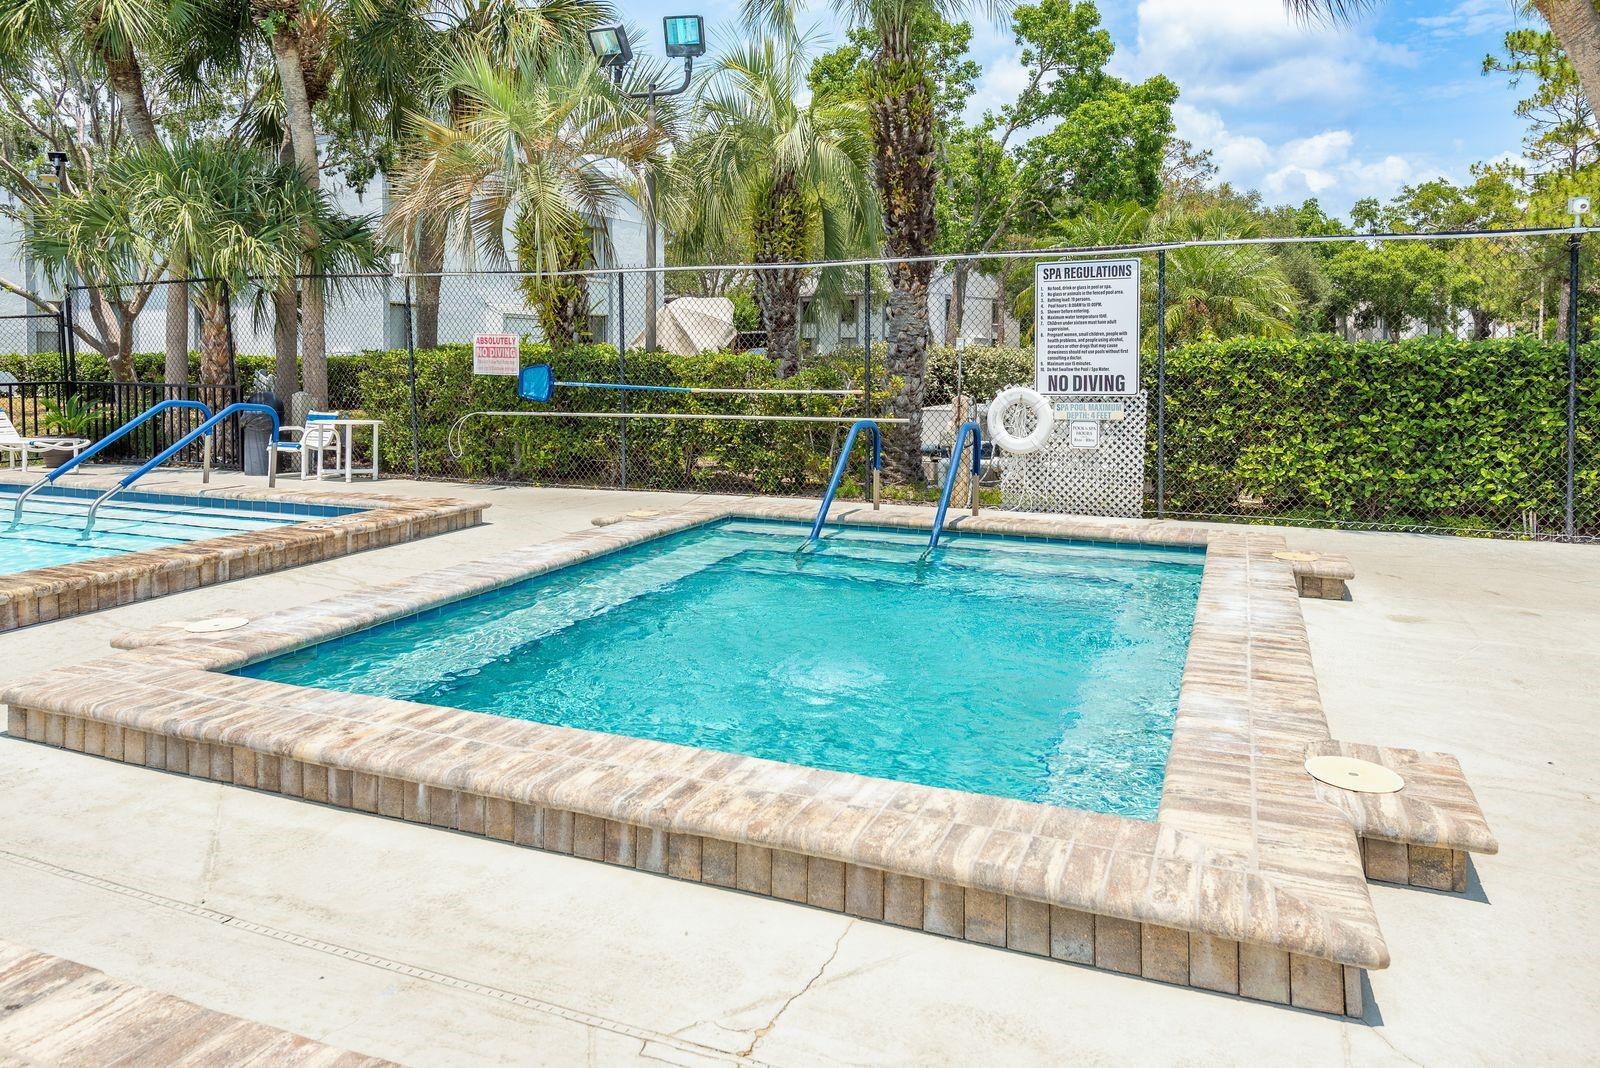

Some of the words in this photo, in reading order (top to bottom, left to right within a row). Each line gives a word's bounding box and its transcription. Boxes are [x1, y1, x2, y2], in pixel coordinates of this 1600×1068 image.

[1043, 267, 1062, 280] SPA
[1064, 264, 1132, 278] REGULATIONS
[477, 348, 487, 357] NO
[489, 348, 516, 358] DIVING
[1048, 375, 1068, 392] NO
[1073, 375, 1125, 392] DIVING
